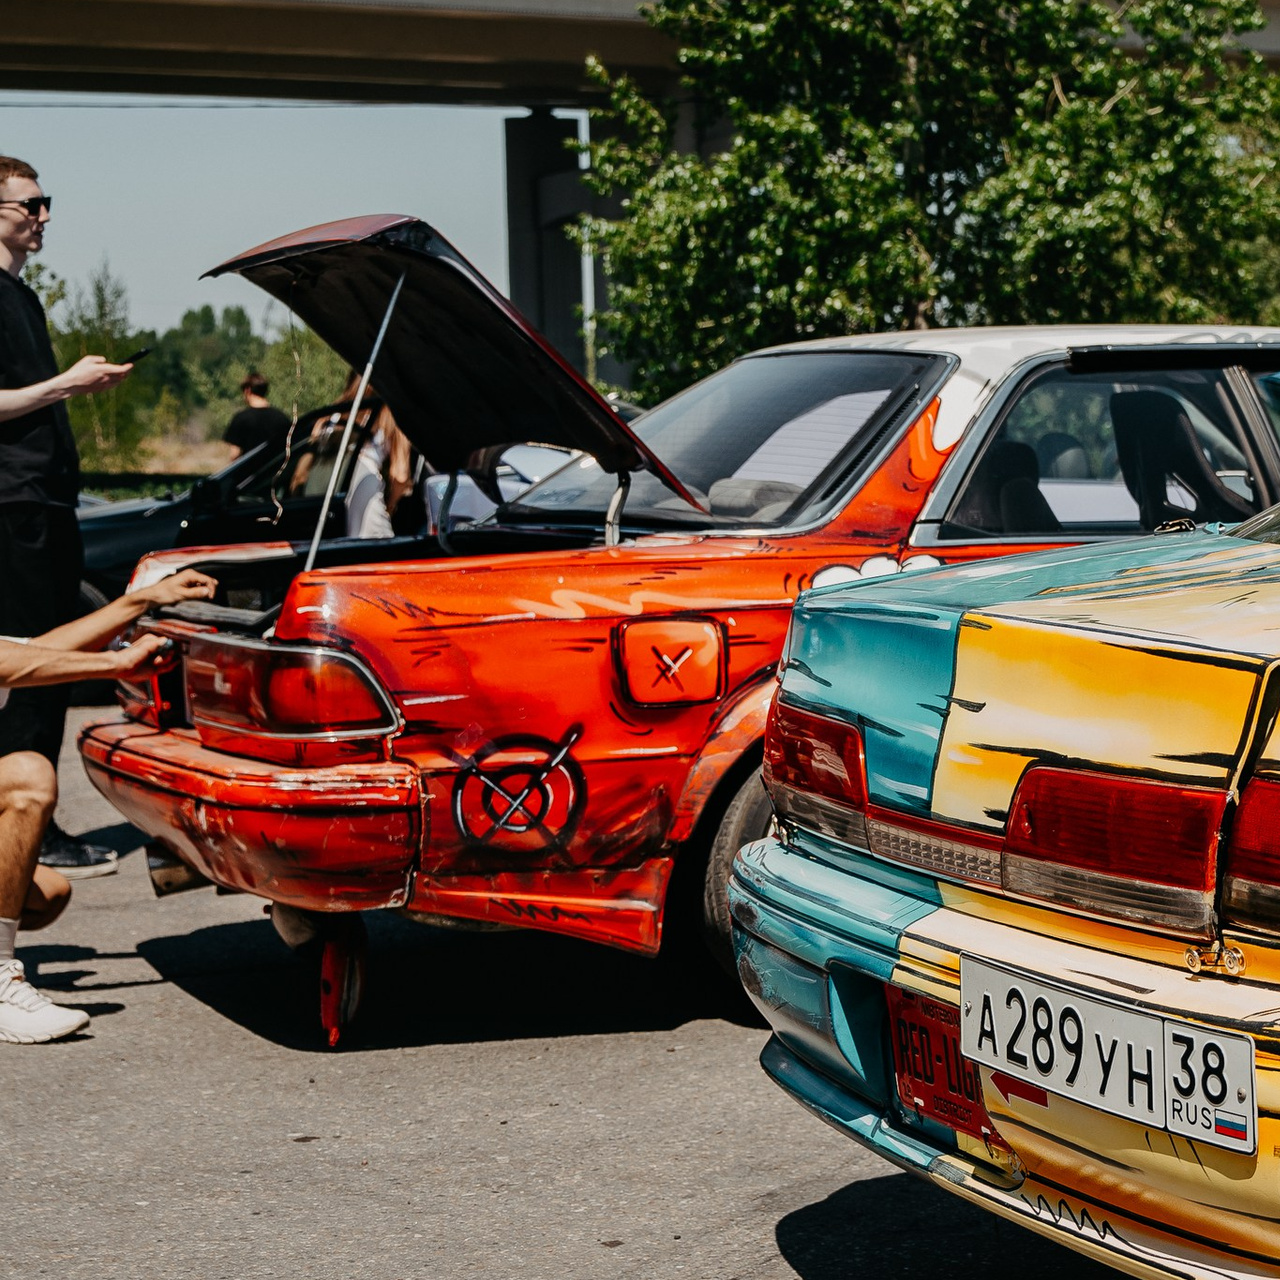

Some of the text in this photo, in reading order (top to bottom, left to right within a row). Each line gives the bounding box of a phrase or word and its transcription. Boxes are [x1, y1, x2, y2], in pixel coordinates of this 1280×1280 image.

[977, 986, 1229, 1114] А289УН 38
[1172, 1098, 1213, 1131] RUS
